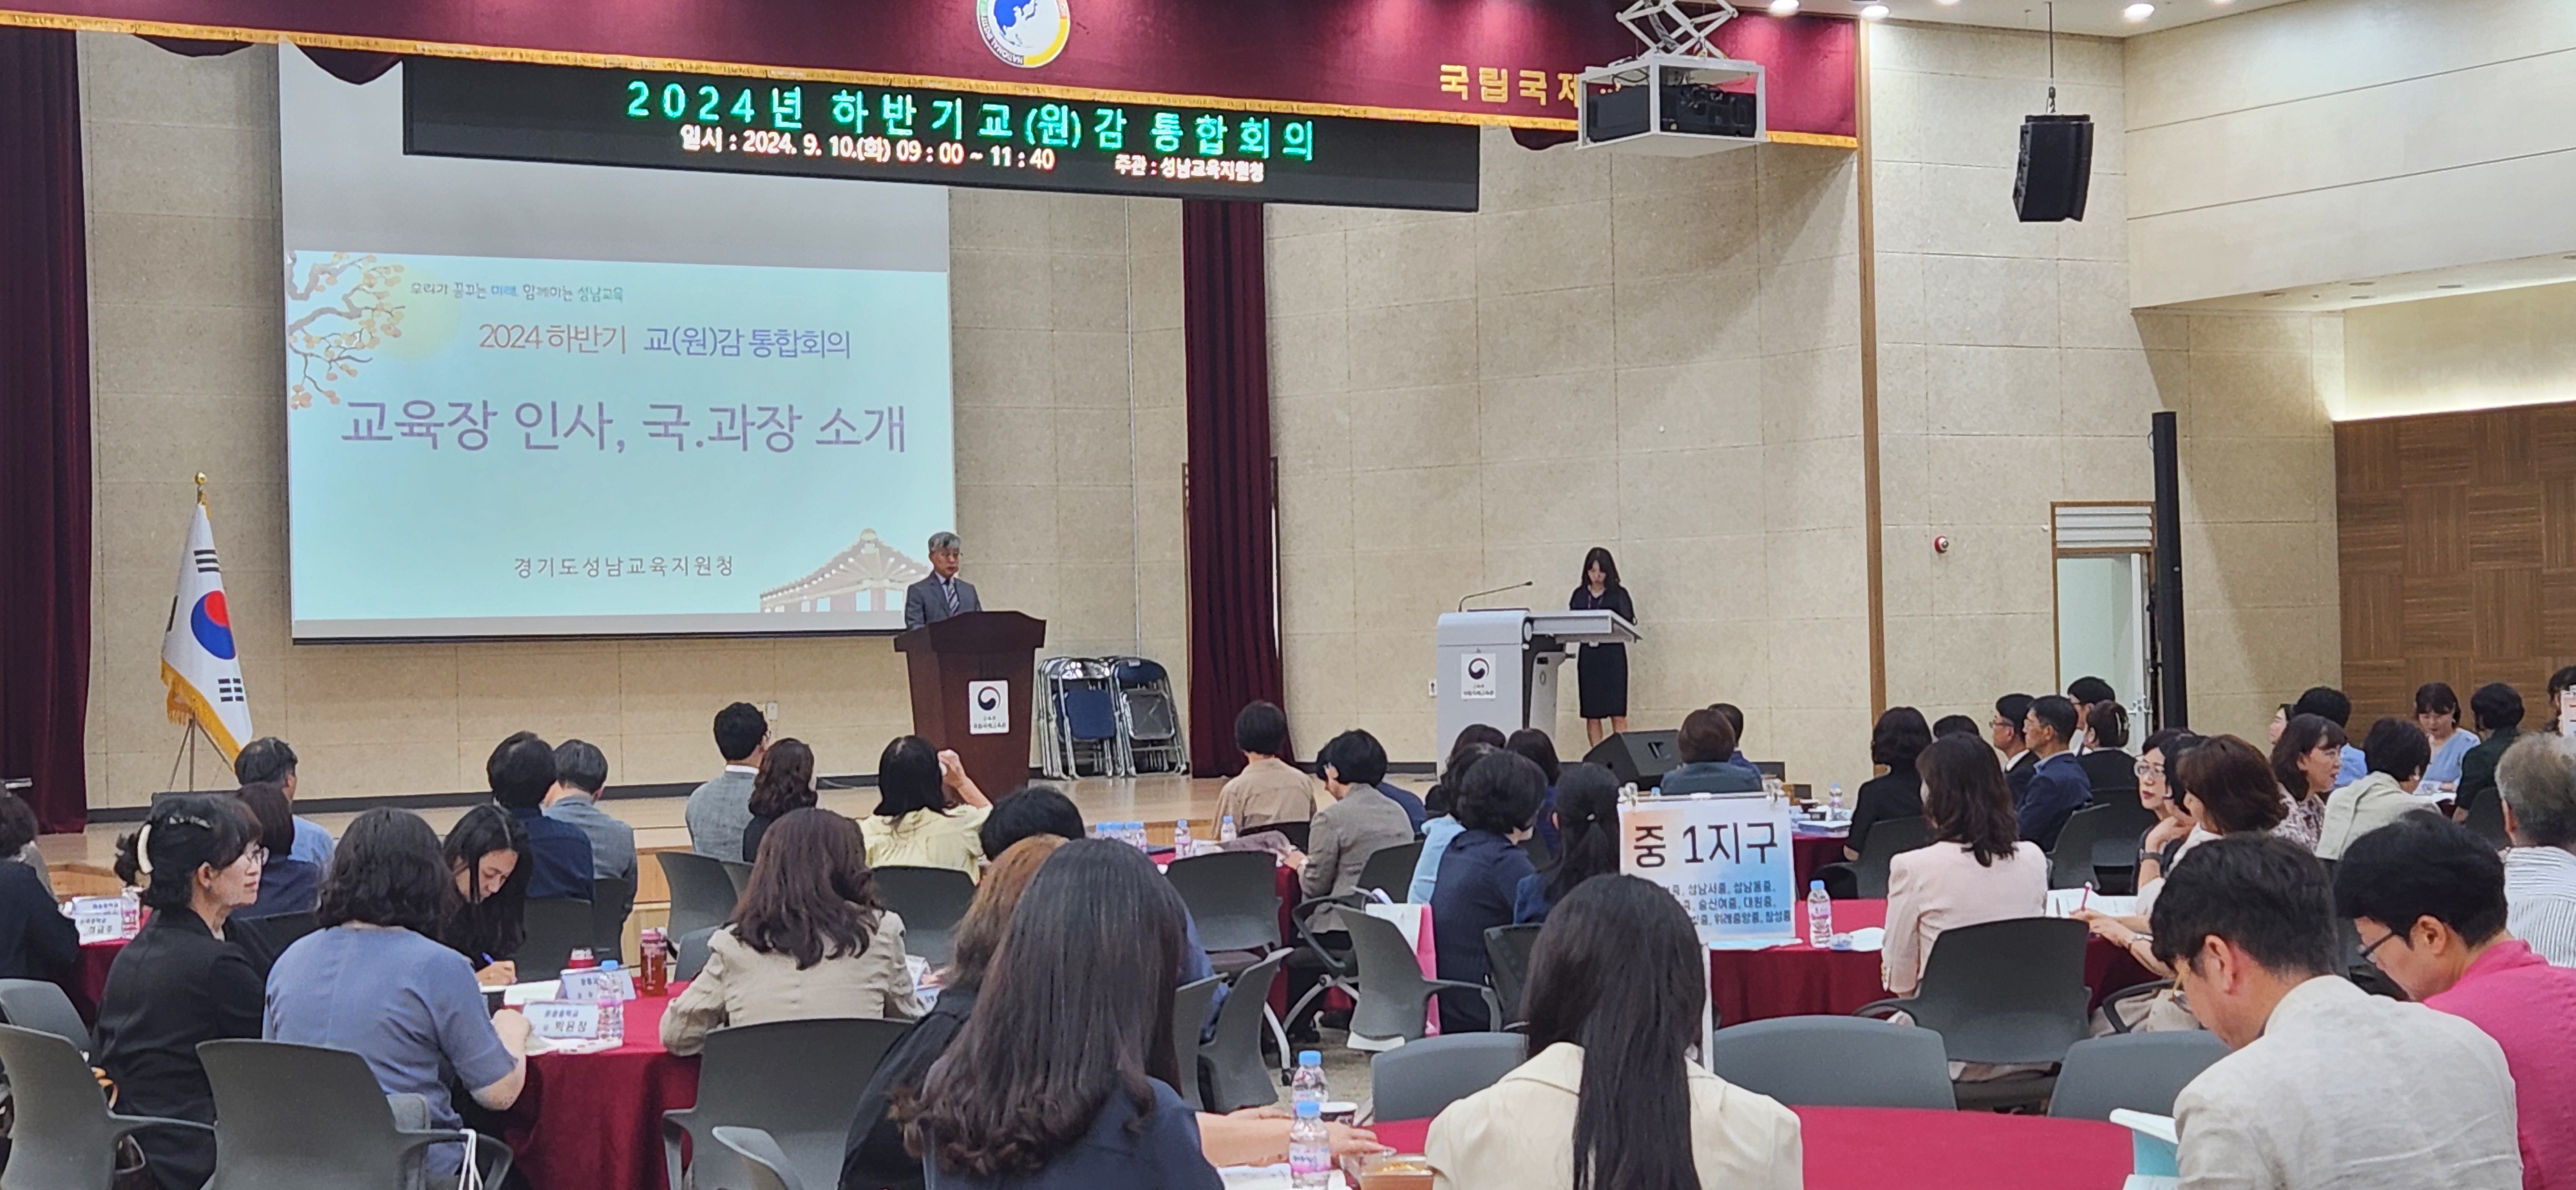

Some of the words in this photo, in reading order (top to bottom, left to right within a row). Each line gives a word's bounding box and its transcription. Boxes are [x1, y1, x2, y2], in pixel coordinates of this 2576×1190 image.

[627, 81, 802, 128] 2024년
[1150, 112, 1314, 161] 통합회의
[680, 124, 723, 153] 일시
[743, 130, 797, 154] 2024.
[1160, 156, 1264, 182] 성남교육지원청
[410, 282, 448, 295] 우리가
[578, 285, 623, 303] 성남교육
[479, 324, 542, 349] 2024
[546, 324, 627, 354] 하반기
[644, 325, 744, 357] 교(원)감
[748, 328, 851, 359] 통합회의
[341, 399, 498, 451] 교육장
[515, 400, 625, 453] 인사,
[642, 403, 803, 453] 국.과장
[815, 405, 905, 453] 소개
[514, 555, 734, 578] 경기도성남교육지원청
[1634, 825, 1667, 868] 중
[1682, 822, 1778, 865] 1지구
